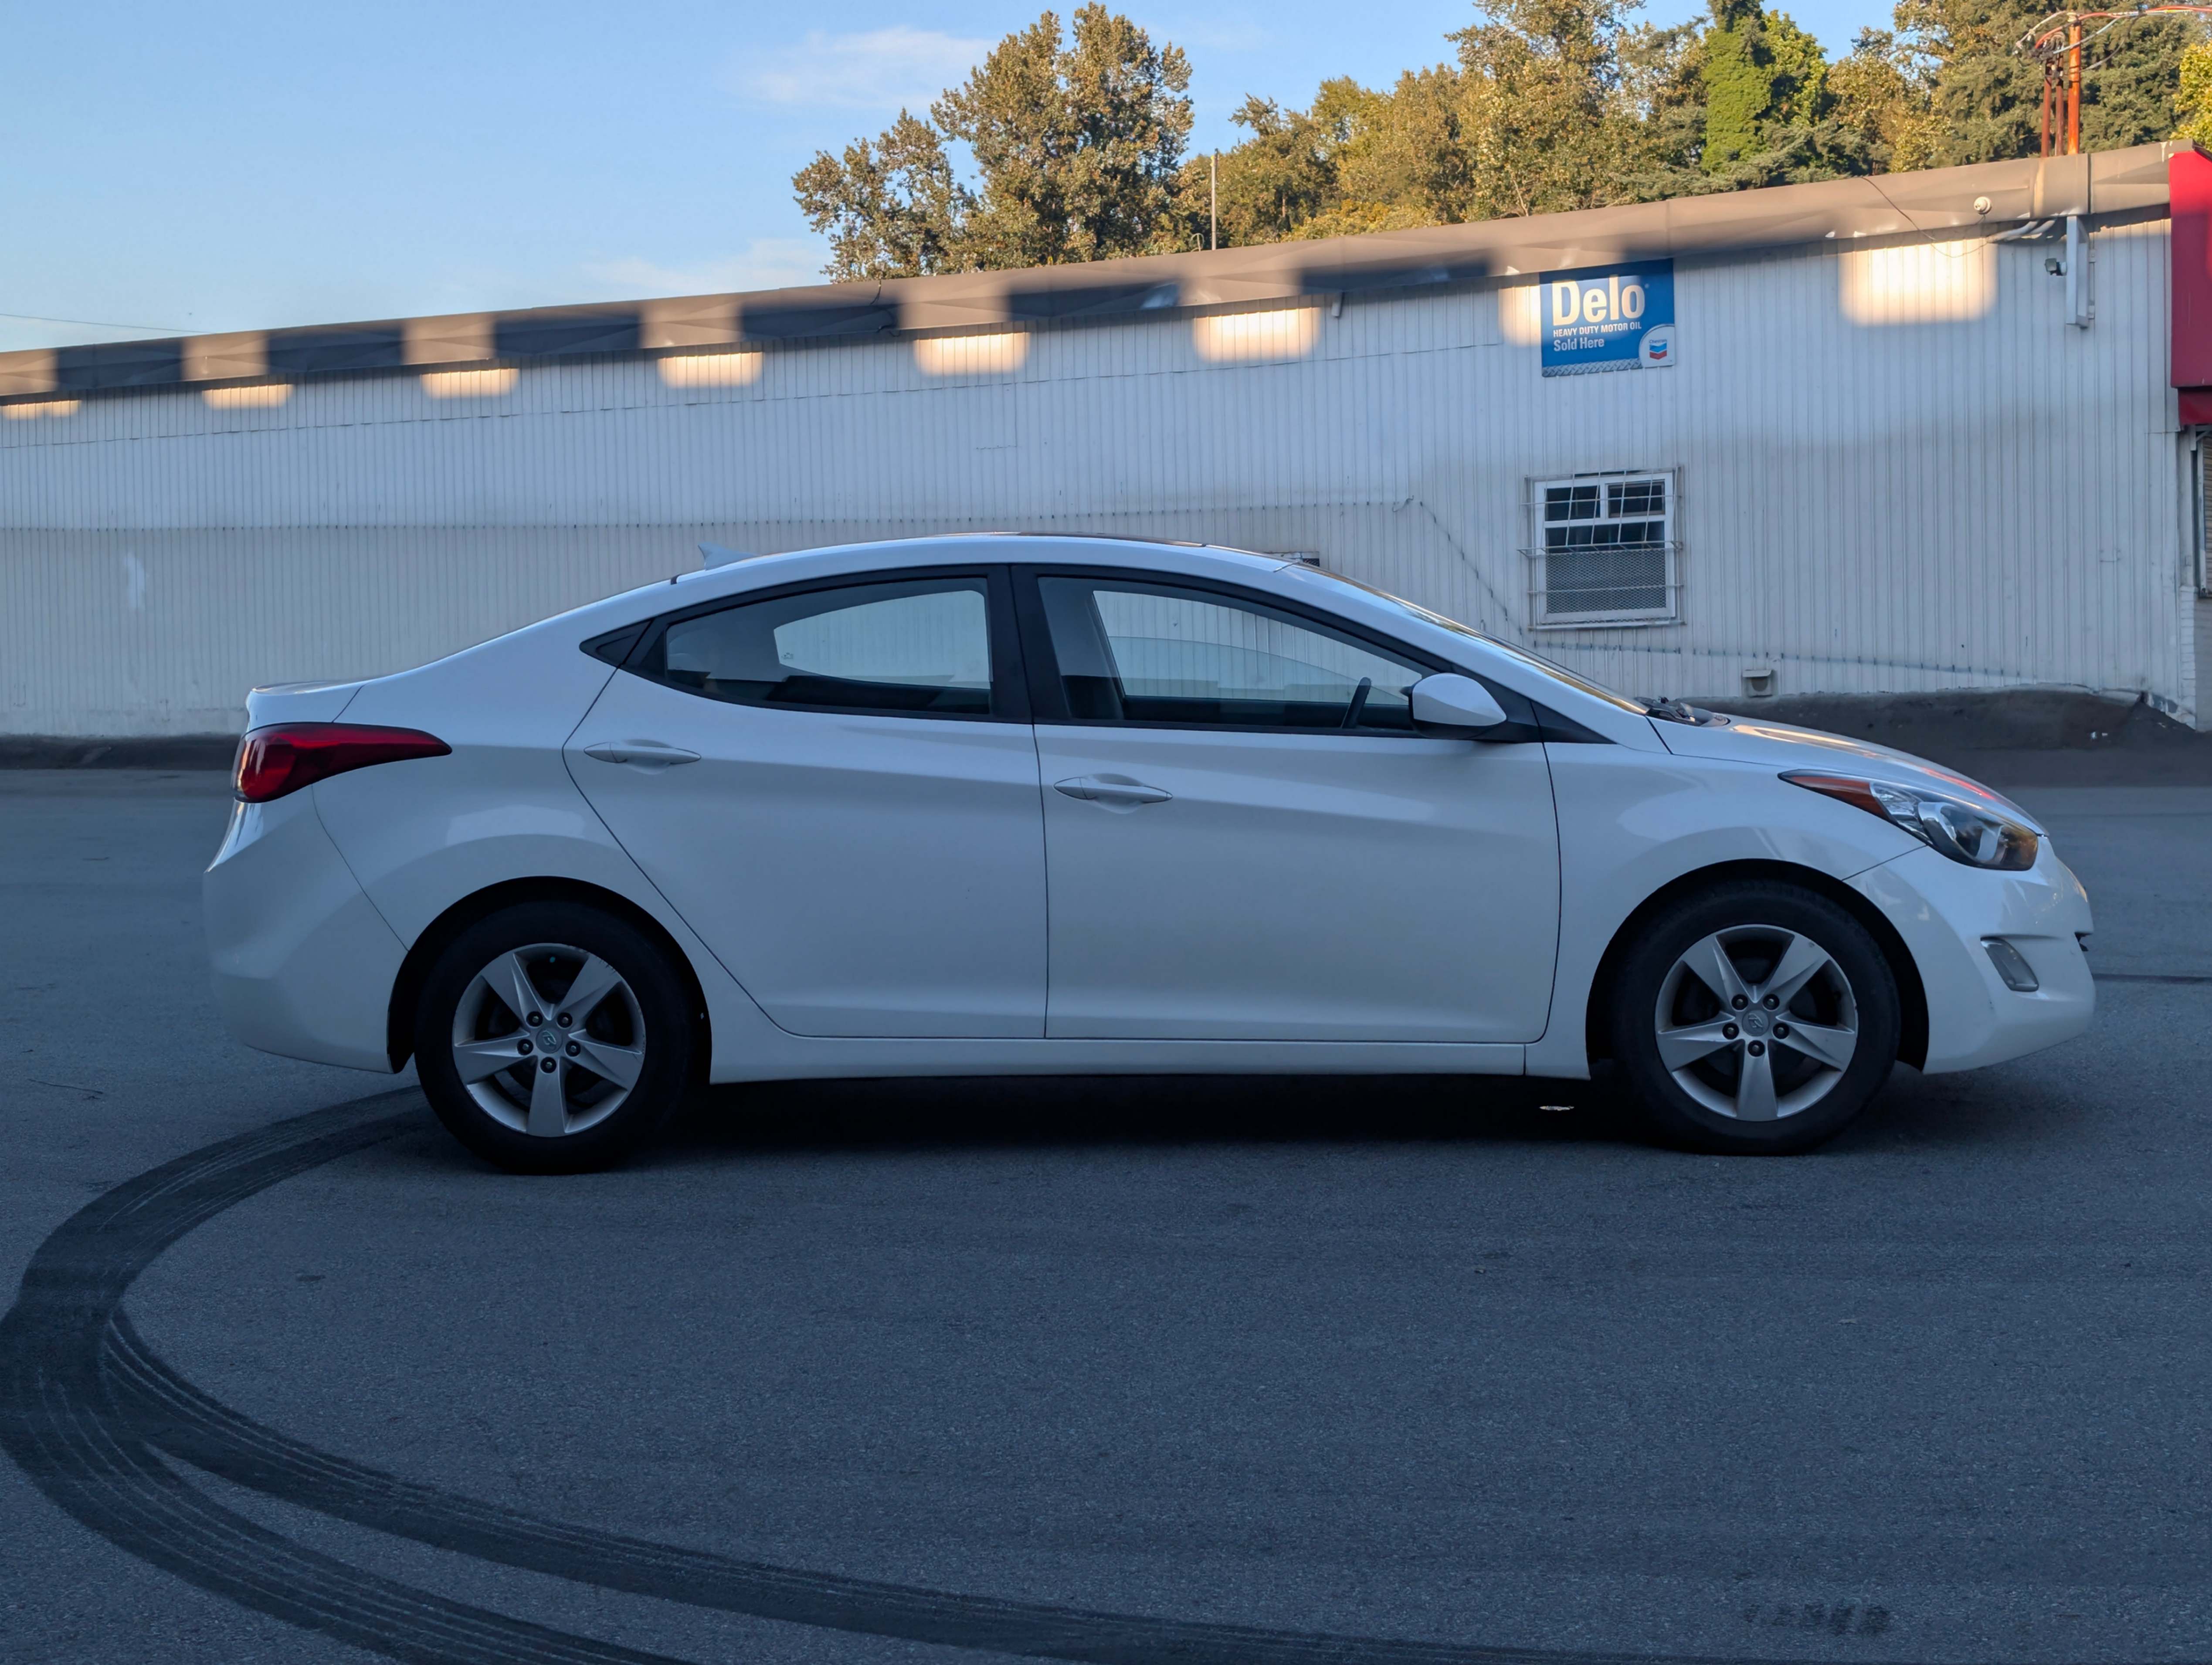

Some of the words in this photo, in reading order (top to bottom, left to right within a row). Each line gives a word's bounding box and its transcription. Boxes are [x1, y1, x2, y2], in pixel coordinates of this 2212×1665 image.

[1552, 275, 1645, 326] Delo
[1553, 328, 1577, 337] HEAVY
[1579, 326, 1599, 334] DUTY
[1601, 323, 1628, 332] MOTOR
[1630, 322, 1642, 330] OIL
[1554, 338, 1577, 351] Sold
[1580, 337, 1605, 349] Here
